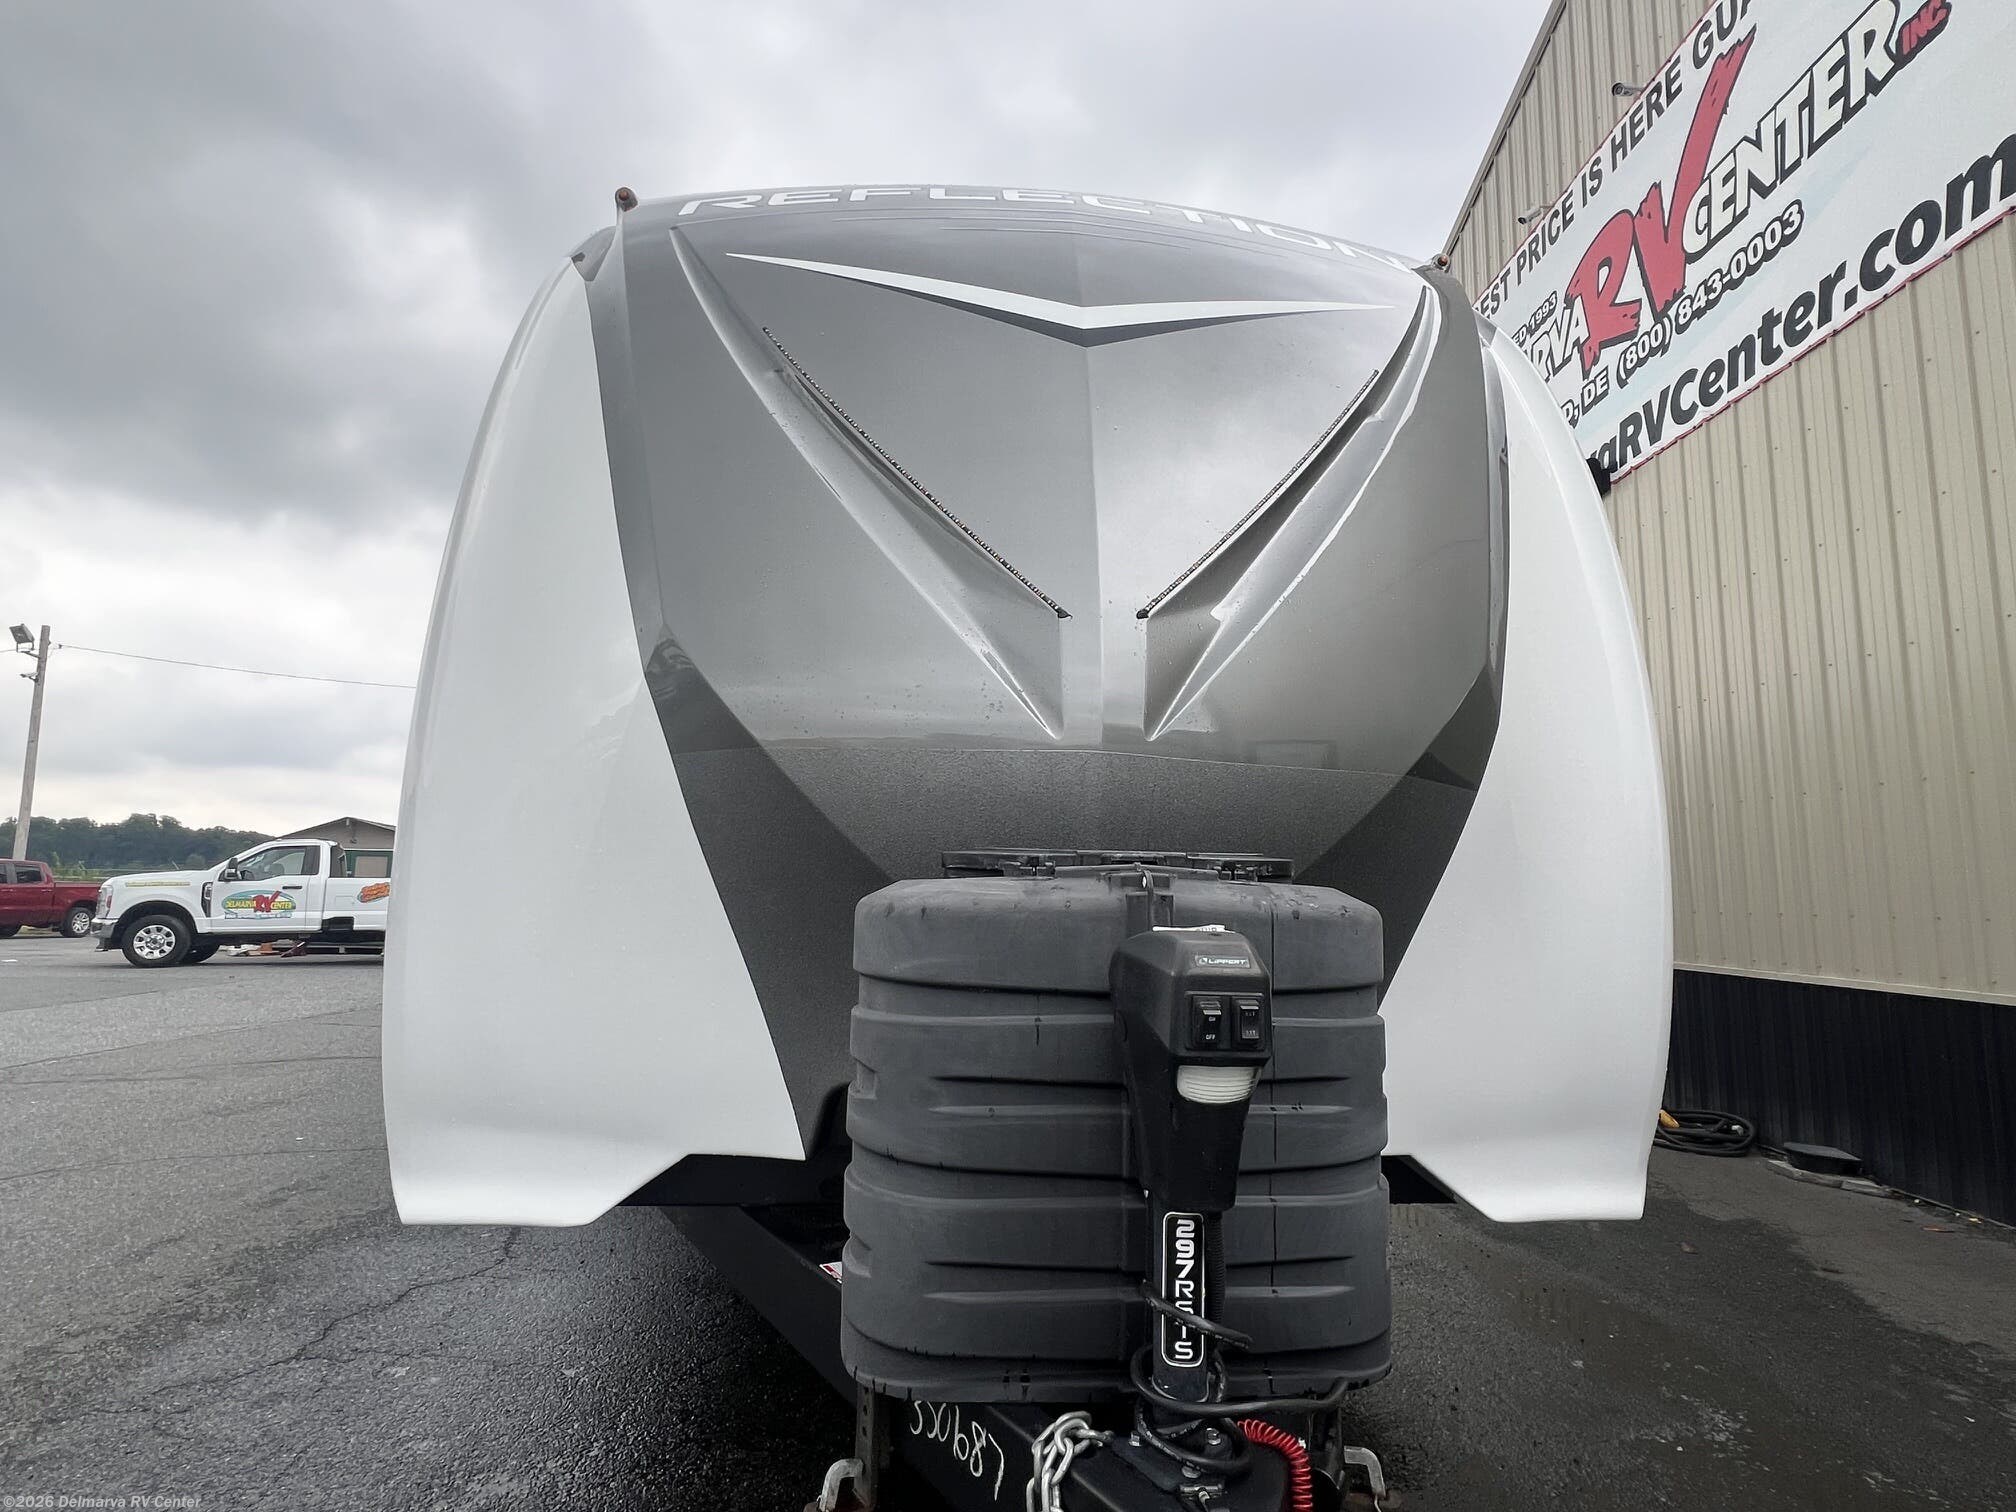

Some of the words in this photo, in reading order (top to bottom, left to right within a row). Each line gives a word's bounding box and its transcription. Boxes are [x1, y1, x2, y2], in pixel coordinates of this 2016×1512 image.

[678, 188, 1413, 274] REFLECTION
[1475, 267, 1512, 318] EST
[1516, 190, 1575, 287] PRICE
[1581, 155, 1604, 208] IS
[1611, 55, 1683, 172] HERE
[1693, 0, 1751, 69] GU
[1565, 22, 1757, 382] RV
[1681, 0, 1898, 265] CENTER
[1528, 291, 1558, 335] 1993
[1580, 366, 1610, 417] DE
[1616, 313, 1674, 390] (800)
[1674, 199, 1804, 336] 843-0003
[1590, 133, 2016, 475] aRVCenter.com
[1208, 957, 1247, 965] LIPPERT
